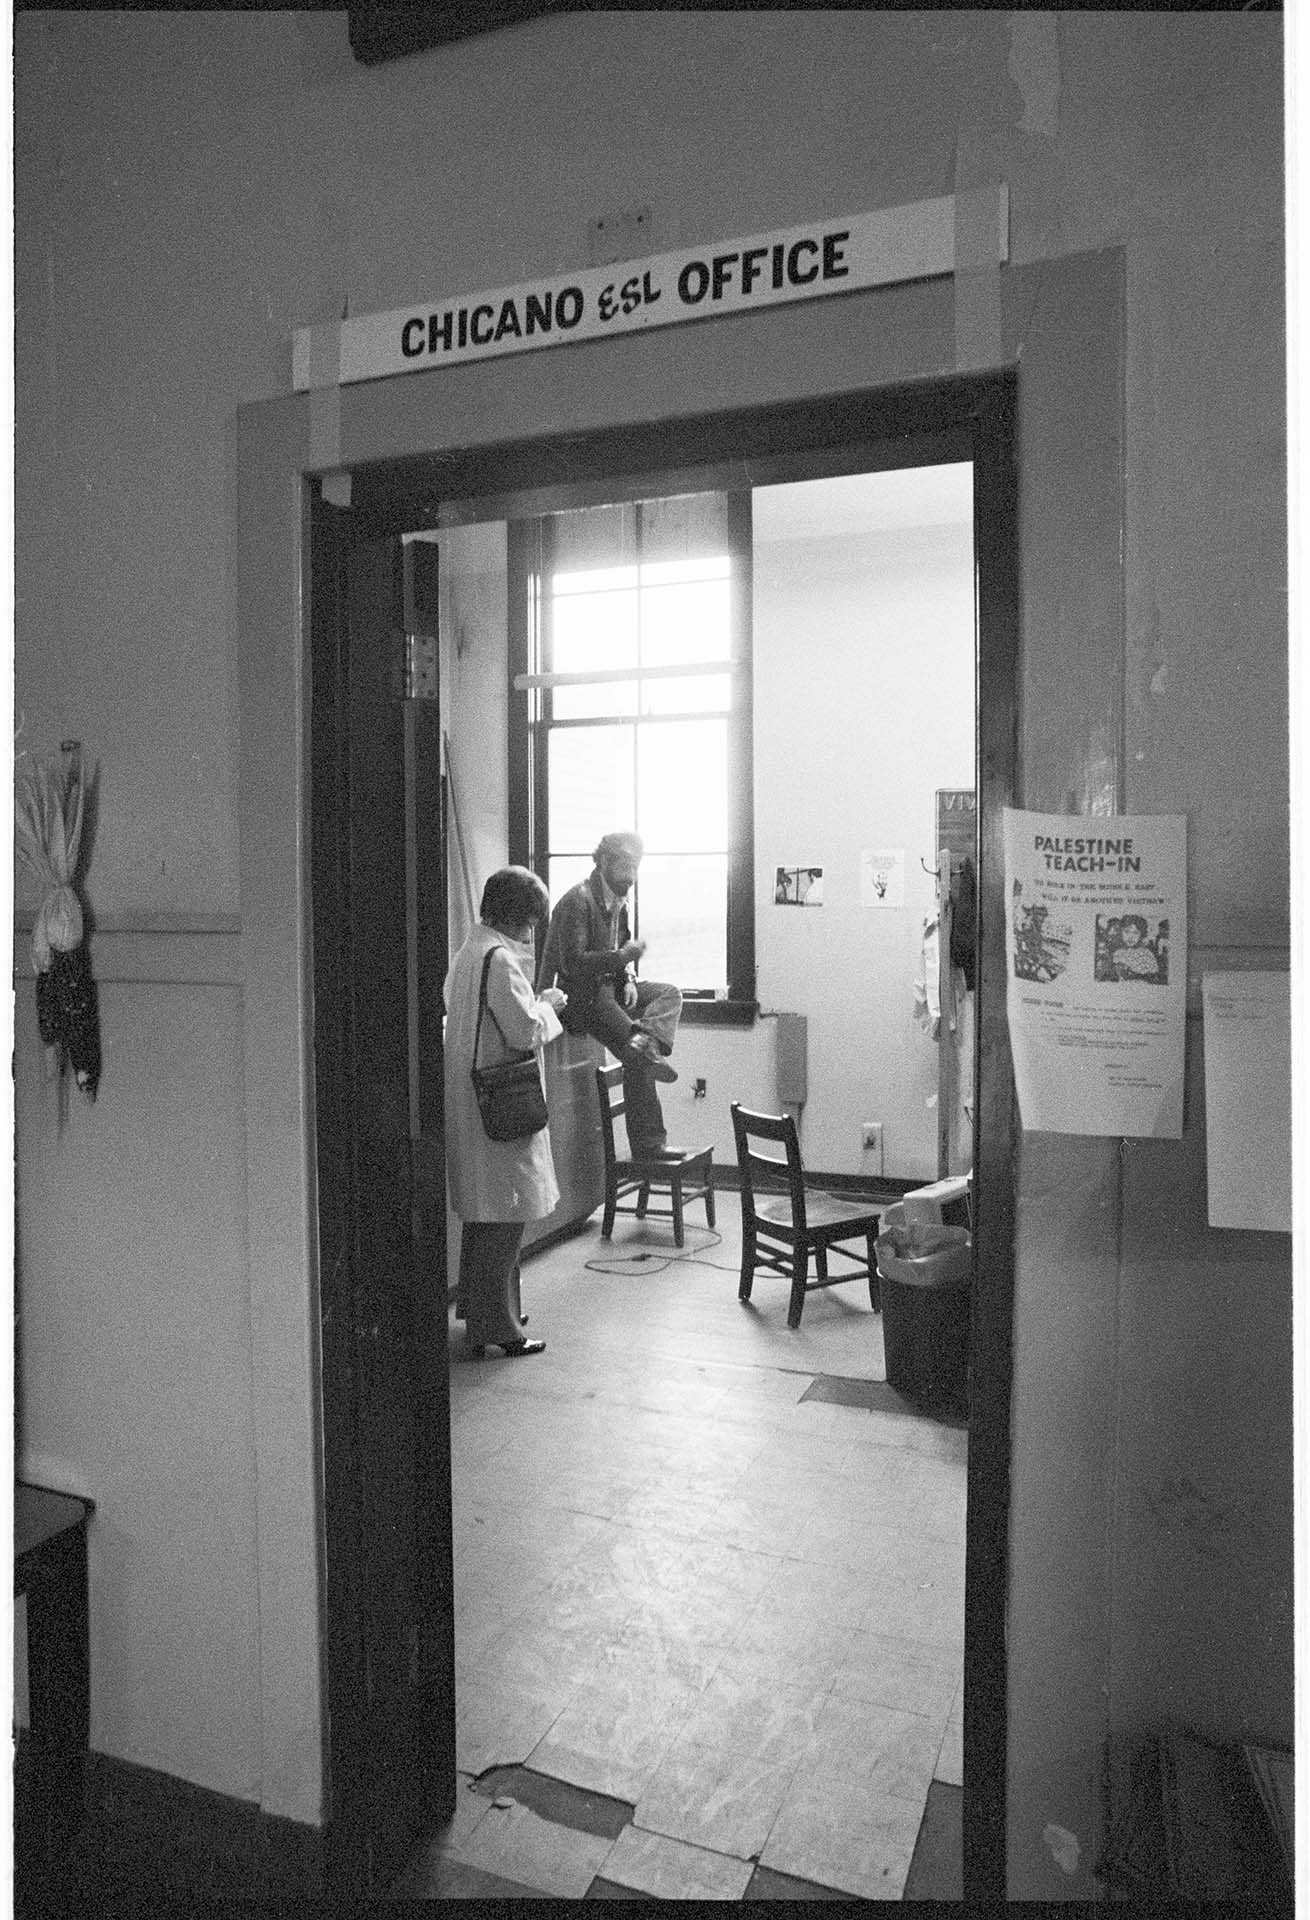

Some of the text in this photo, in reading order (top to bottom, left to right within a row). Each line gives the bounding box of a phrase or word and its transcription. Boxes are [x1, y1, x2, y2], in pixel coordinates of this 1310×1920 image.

[401, 230, 851, 359] CHICANO ESL OFFICE
[1034, 835, 1134, 855] PALESTINE
[1044, 853, 1141, 873] TEACH-IN
